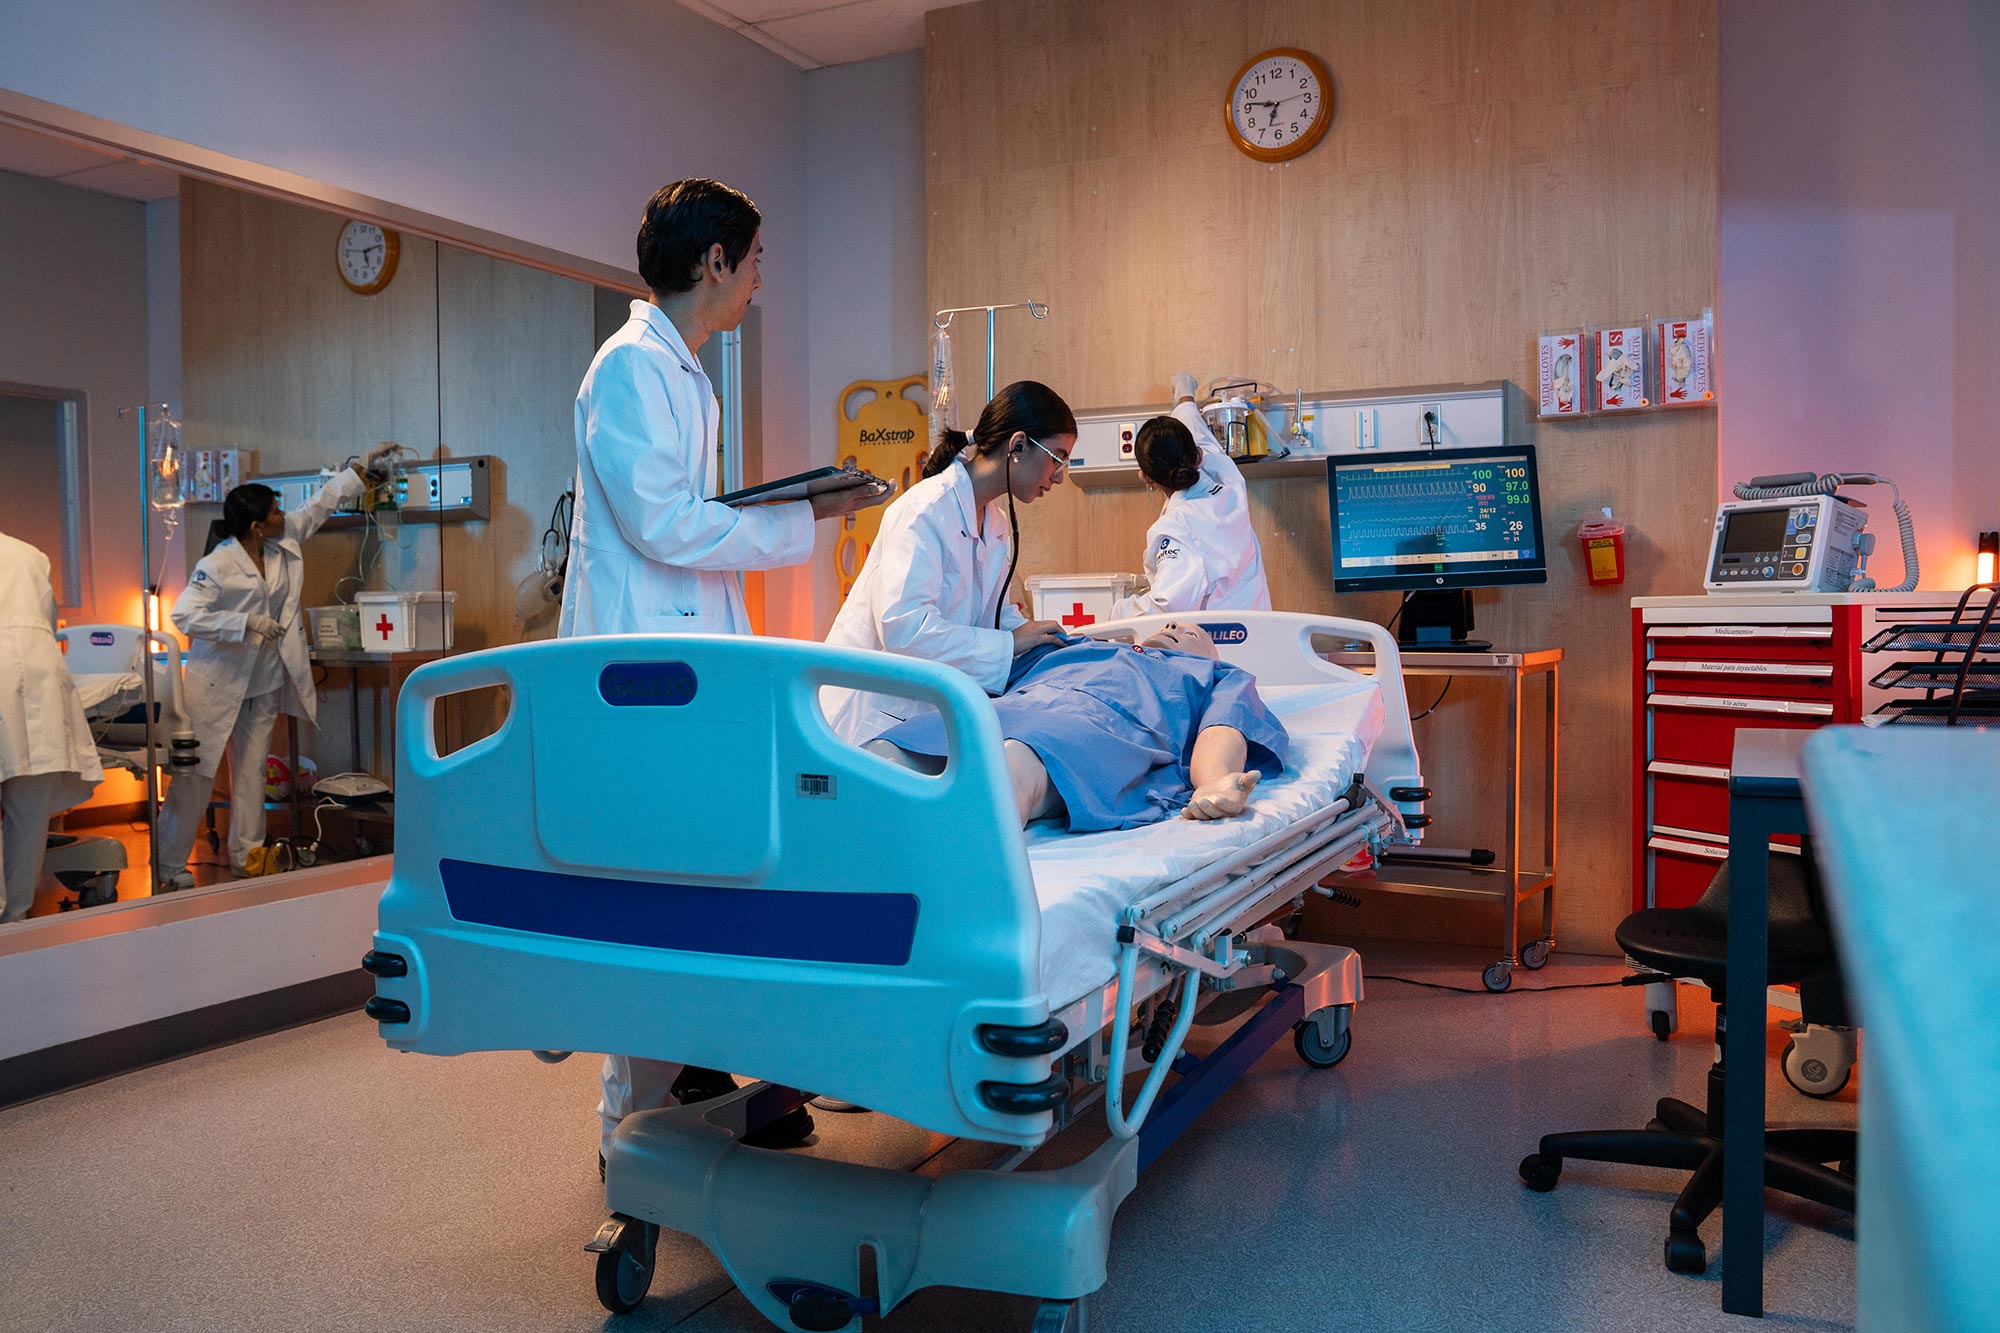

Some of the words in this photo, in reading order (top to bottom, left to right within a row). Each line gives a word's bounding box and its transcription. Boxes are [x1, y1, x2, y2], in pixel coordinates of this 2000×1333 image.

[1269, 68, 1283, 79] 12
[1289, 69, 1295, 79] 1
[1255, 75, 1266, 85] 11
[1299, 78, 1308, 89] 2
[1244, 88, 1257, 99] 10
[1303, 92, 1312, 104] 3
[1244, 103, 1252, 114] 9
[1300, 109, 1308, 119] 4
[1248, 117, 1256, 128] 8
[1290, 122, 1299, 133] 5
[1258, 128, 1266, 139] 7
[1274, 129, 1283, 140] 6
[1673, 326, 1686, 336] L
[1609, 334, 1622, 343] S
[1697, 327, 1705, 352] MEDI
[1632, 336, 1640, 360] MEDI
[1541, 344, 1549, 381] GLOVES
[1697, 354, 1706, 393] GLOVES
[1542, 383, 1550, 407] MEDI
[860, 428, 915, 443] BaXstrap
[1472, 469, 1492, 480] 100
[1505, 467, 1525, 478] 100
[1472, 482, 1487, 493] 90
[1505, 481, 1529, 491] 97.0
[1507, 494, 1530, 504] 99.0
[1475, 522, 1487, 531] 35
[1509, 521, 1523, 531] 26
[1208, 630, 1245, 641] ALILEO
[1713, 627, 1754, 635] Medicamentos
